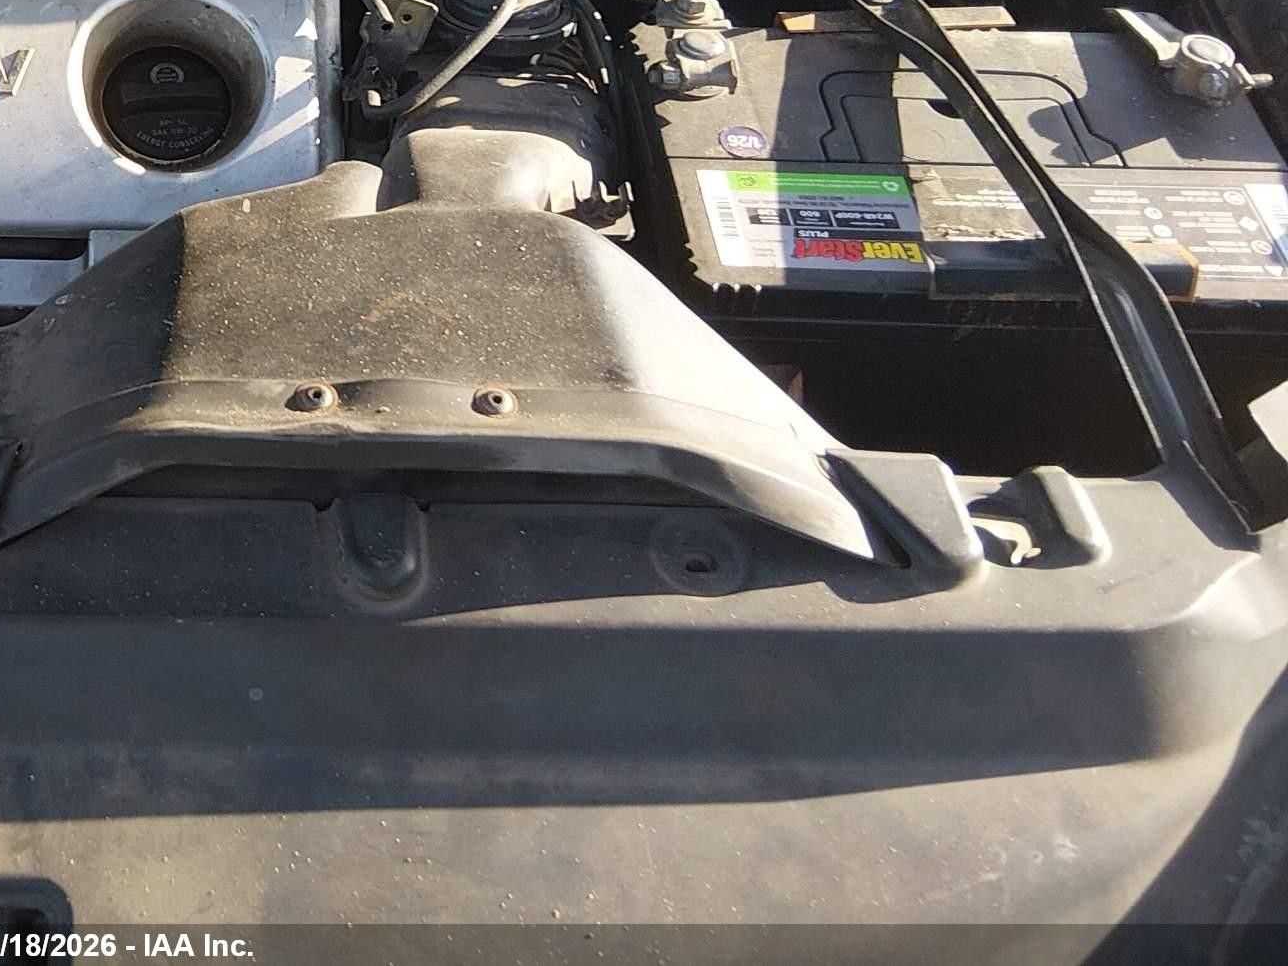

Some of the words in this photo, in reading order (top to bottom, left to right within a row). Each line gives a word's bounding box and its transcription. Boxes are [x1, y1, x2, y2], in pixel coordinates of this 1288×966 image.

[136, 130, 167, 147] ENERGY
[797, 229, 830, 239] PLUS
[793, 239, 924, 265] EverStart
